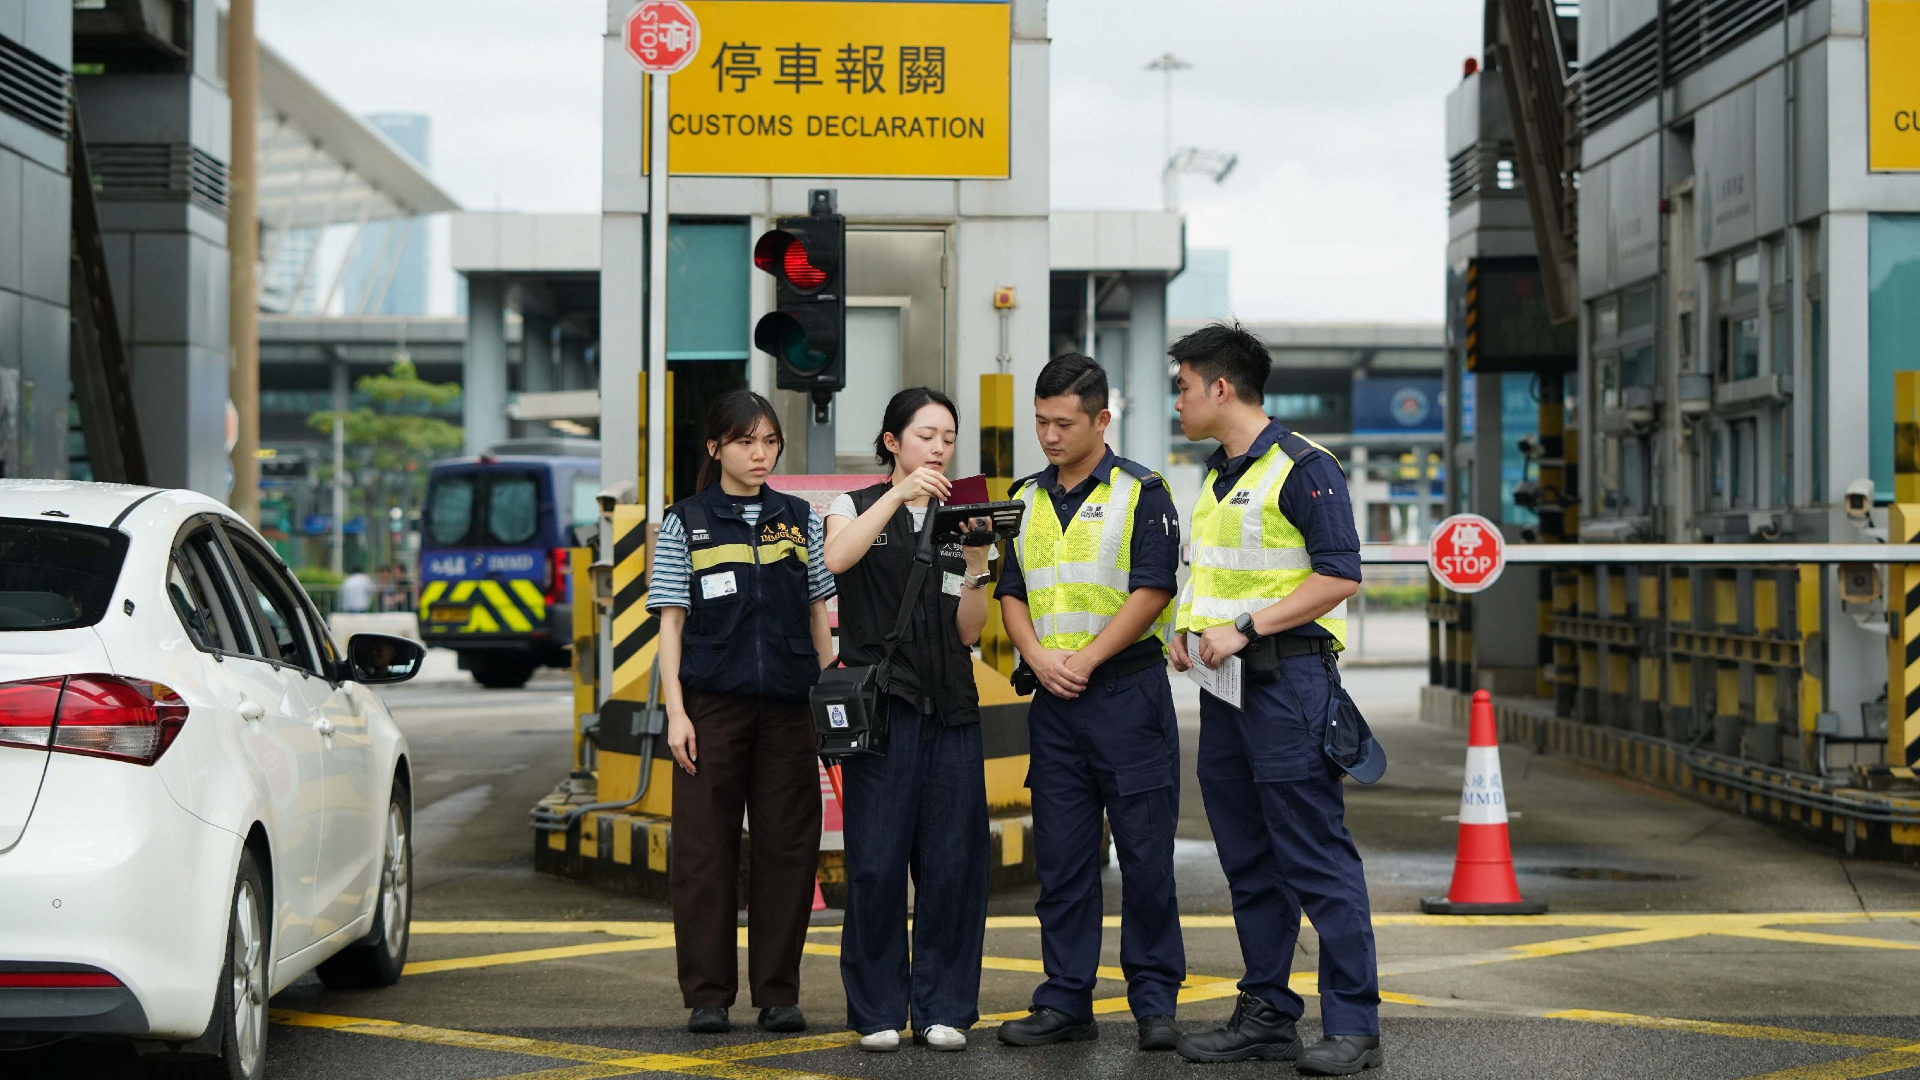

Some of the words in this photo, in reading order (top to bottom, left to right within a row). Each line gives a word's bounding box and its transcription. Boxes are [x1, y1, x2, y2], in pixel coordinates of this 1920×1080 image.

[640, 10, 658, 60] STOP
[659, 19, 691, 52] 停
[711, 41, 946, 95] 停車報關
[668, 113, 793, 136] CUSTOMS
[807, 115, 985, 138] DECLARATION
[1450, 525, 1482, 555] 停
[1441, 556, 1491, 575] STOP
